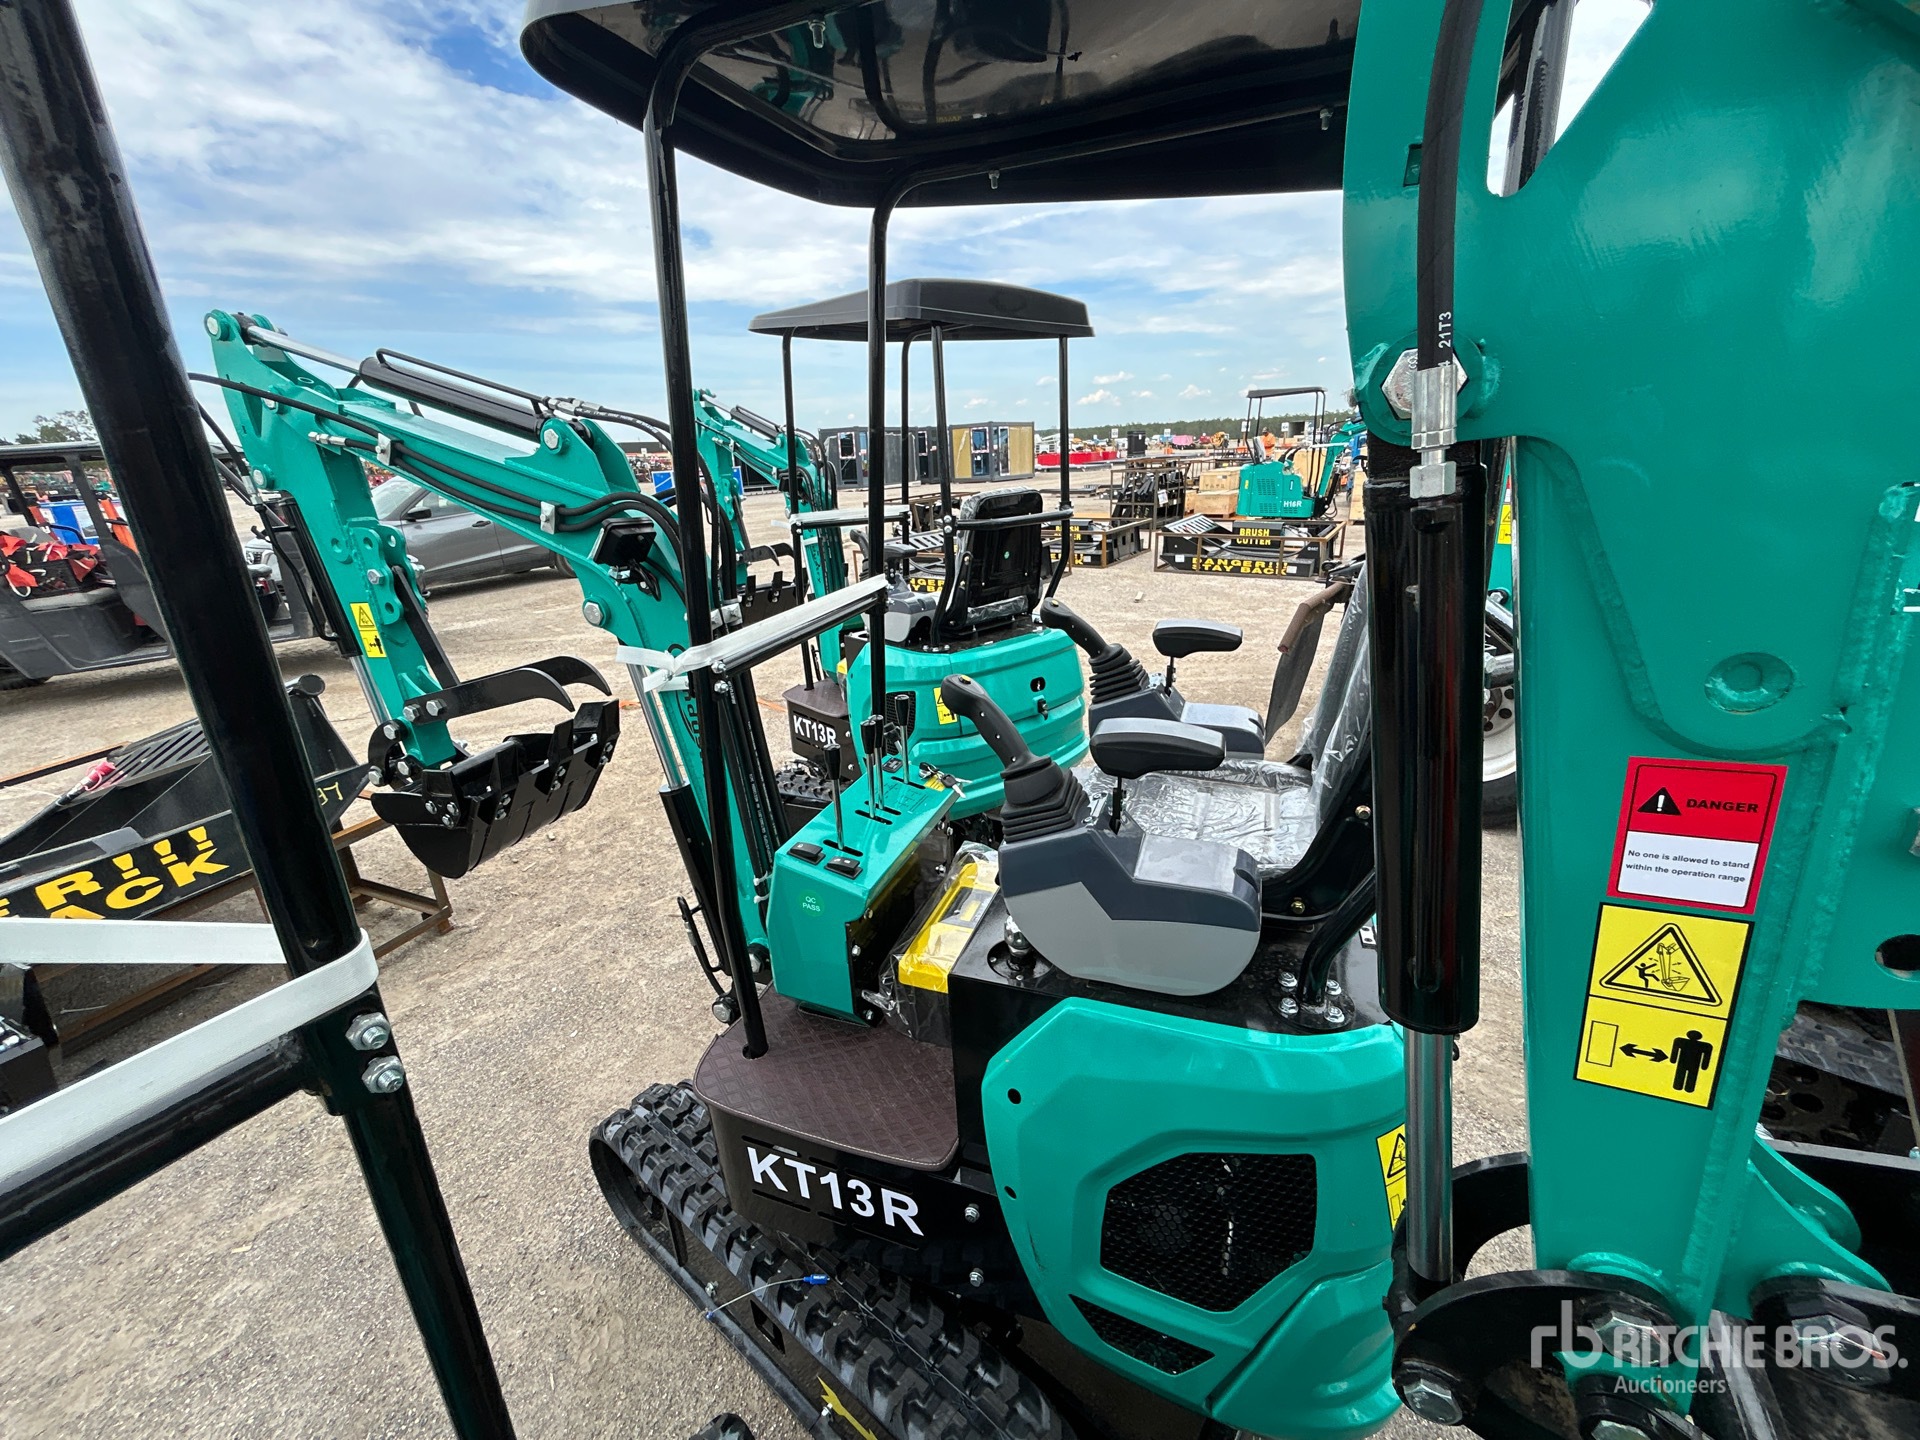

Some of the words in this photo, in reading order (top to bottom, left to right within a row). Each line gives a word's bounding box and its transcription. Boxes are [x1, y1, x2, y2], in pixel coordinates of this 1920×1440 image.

[1438, 311, 1452, 349] 21T3
[1239, 527, 1270, 537] BRUSH
[1236, 537, 1271, 546] CUTTER
[793, 715, 837, 745] KT13R
[1686, 798, 1759, 813] DANGER
[1627, 849, 1641, 858] No
[1642, 852, 1660, 860] one
[1661, 852, 1670, 861] is
[1672, 854, 1708, 865] allowed
[1710, 858, 1720, 867] to
[1722, 859, 1750, 870] stand
[1625, 862, 1653, 872] within
[1654, 864, 1669, 874] the
[1671, 868, 1716, 880] operation
[1717, 873, 1746, 884] range
[802, 902, 821, 912] PASS
[805, 895, 817, 904] QC
[746, 1146, 925, 1237] KT13R
